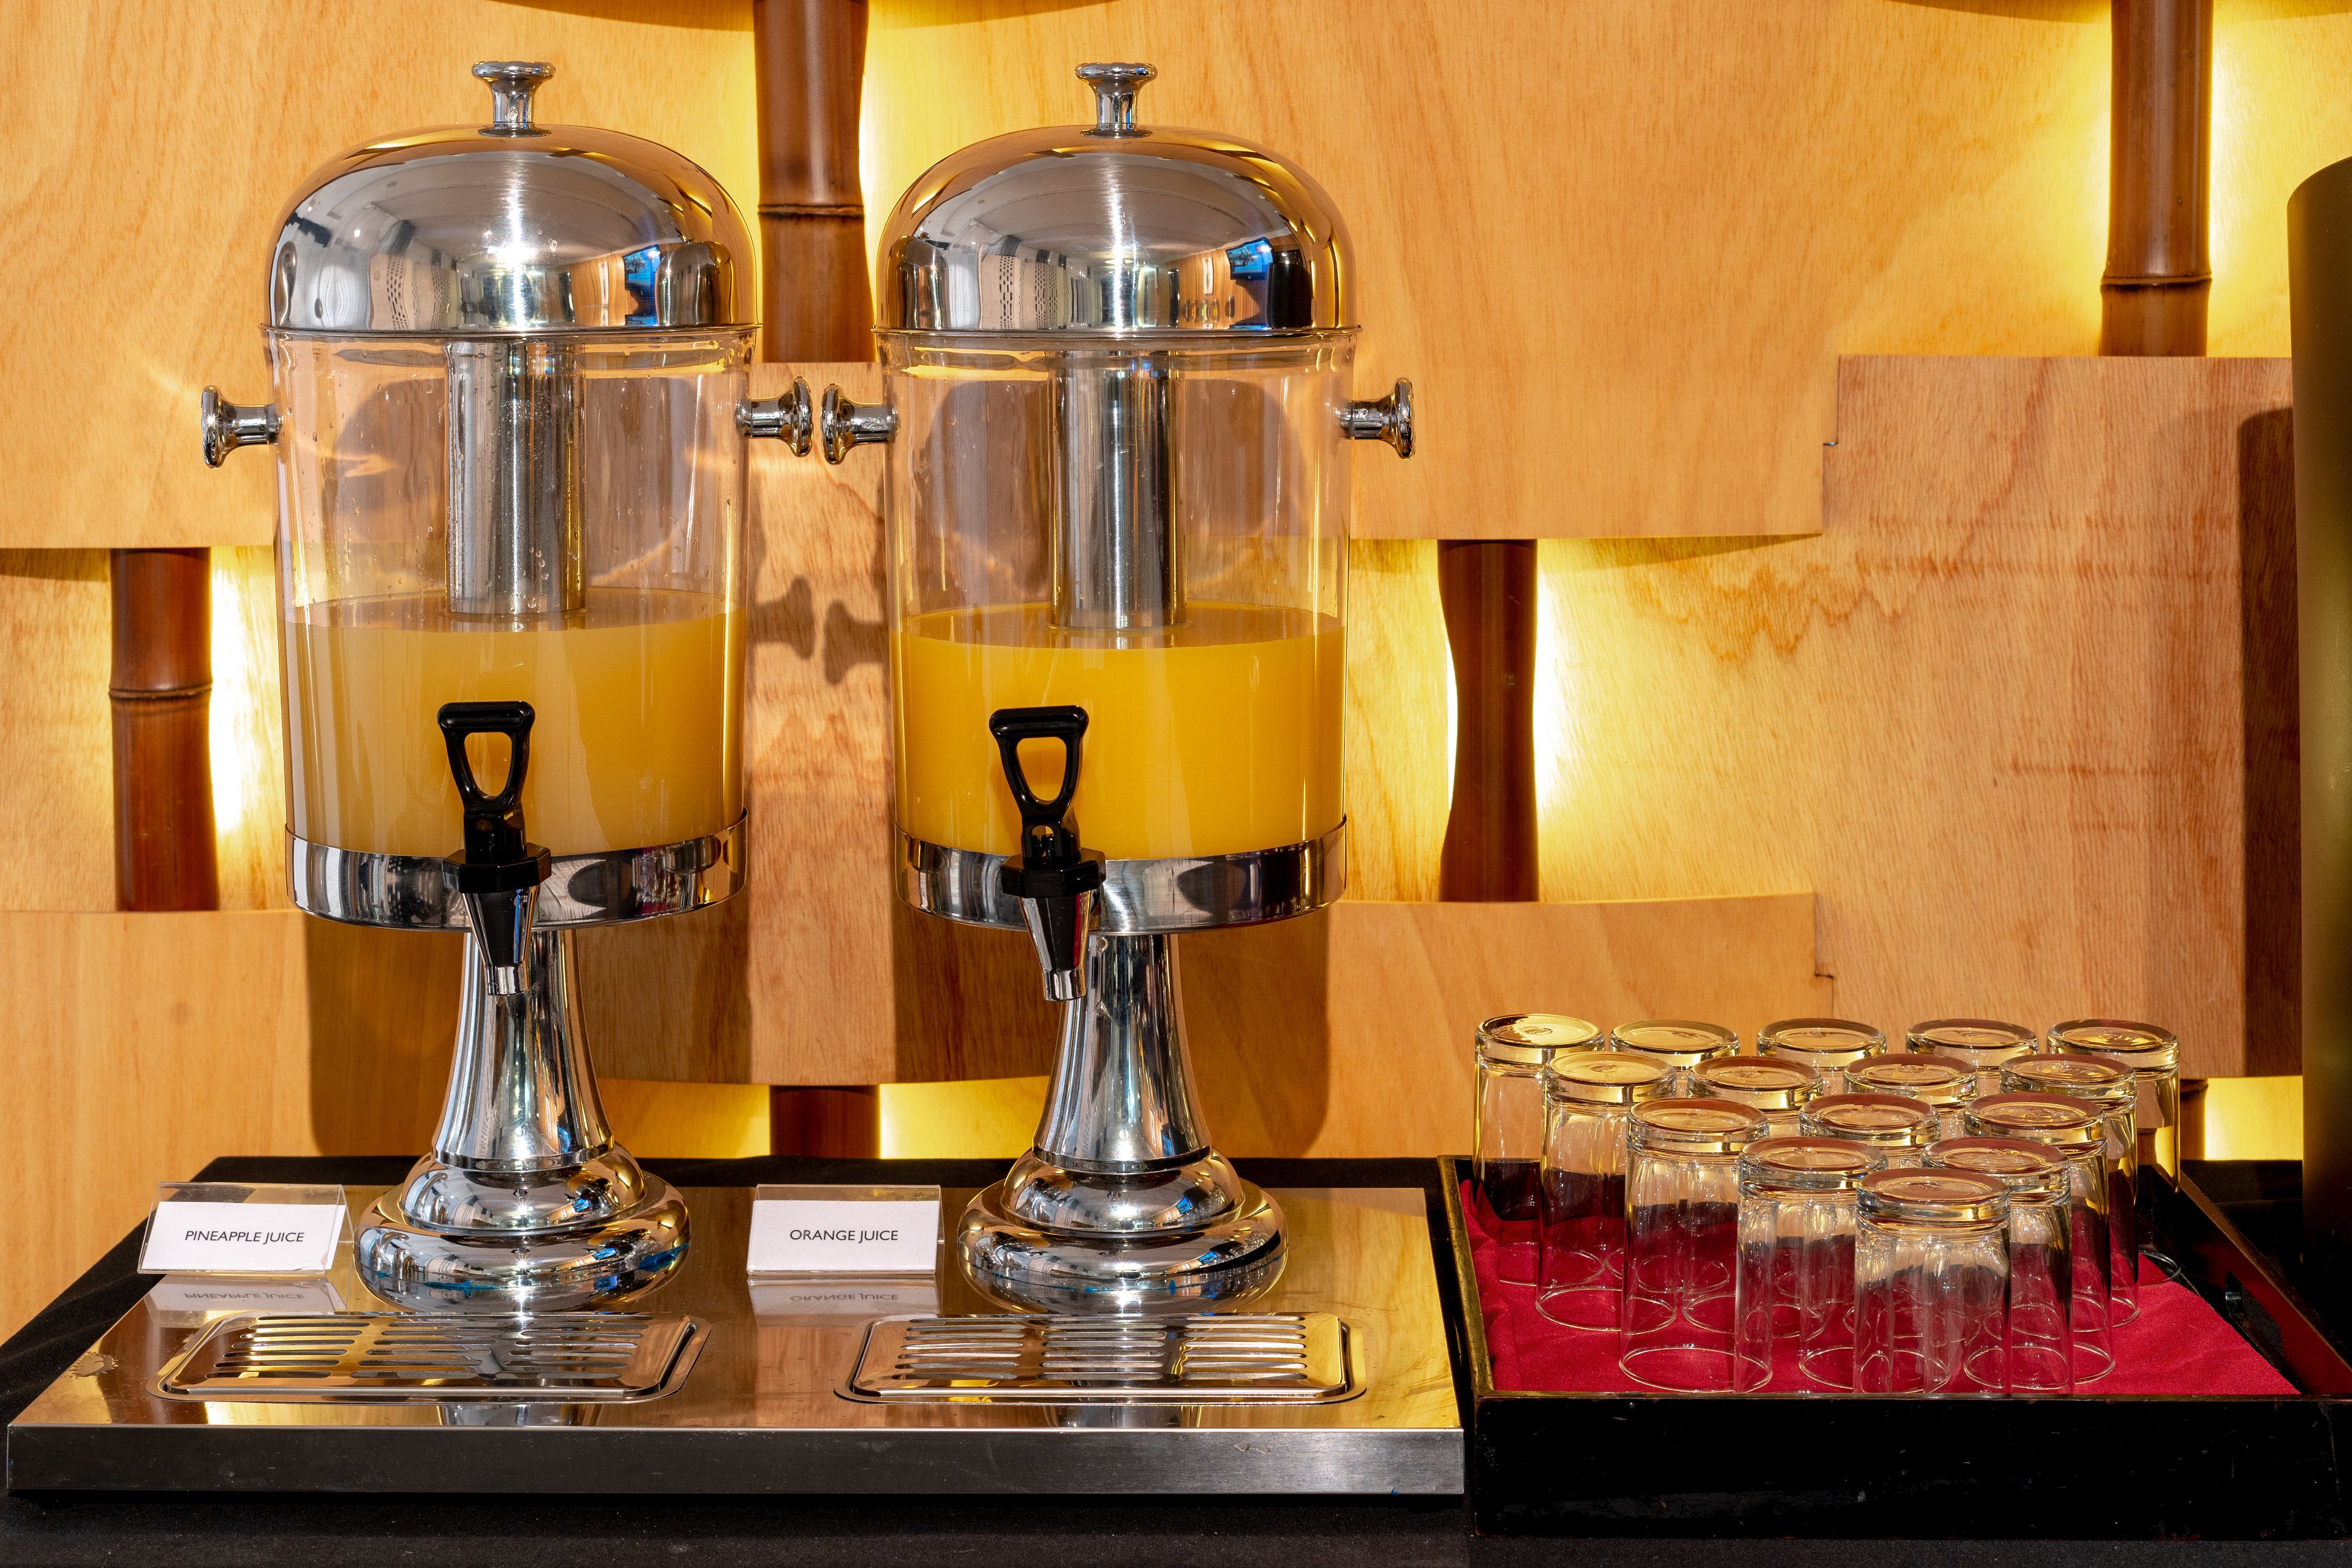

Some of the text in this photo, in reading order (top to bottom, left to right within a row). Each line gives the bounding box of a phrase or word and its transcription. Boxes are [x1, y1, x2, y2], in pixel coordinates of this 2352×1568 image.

[184, 1230, 306, 1245] PINEAPPLE JUICE
[790, 1229, 899, 1244] ORANGE JUICE
